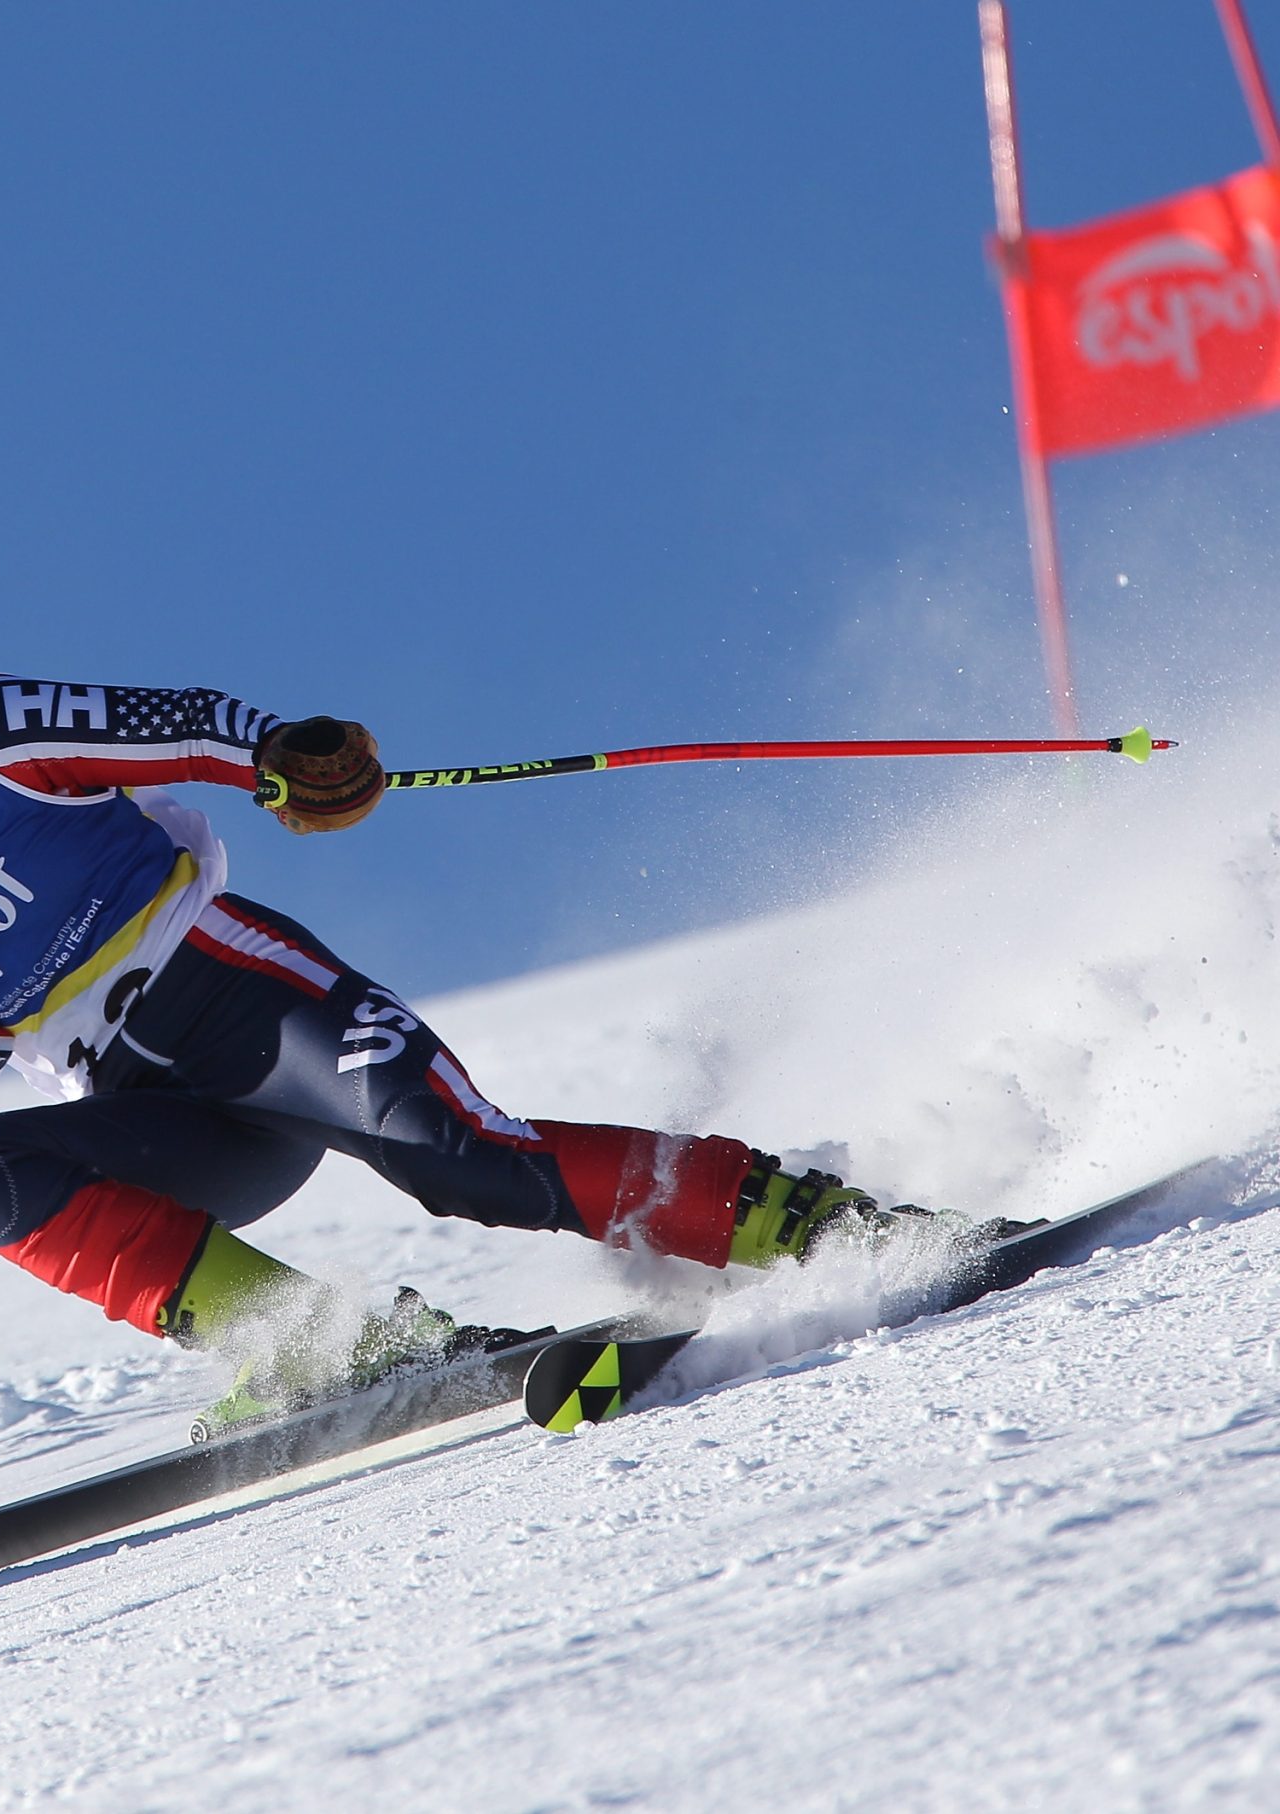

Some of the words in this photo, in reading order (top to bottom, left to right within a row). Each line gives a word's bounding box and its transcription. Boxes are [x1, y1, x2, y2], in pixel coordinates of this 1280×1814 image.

[1, 684, 108, 731] HH
[388, 771, 474, 789] LEKI
[33, 916, 76, 974] Catalunya
[55, 952, 70, 969] de
[65, 898, 103, 951] l'Esport
